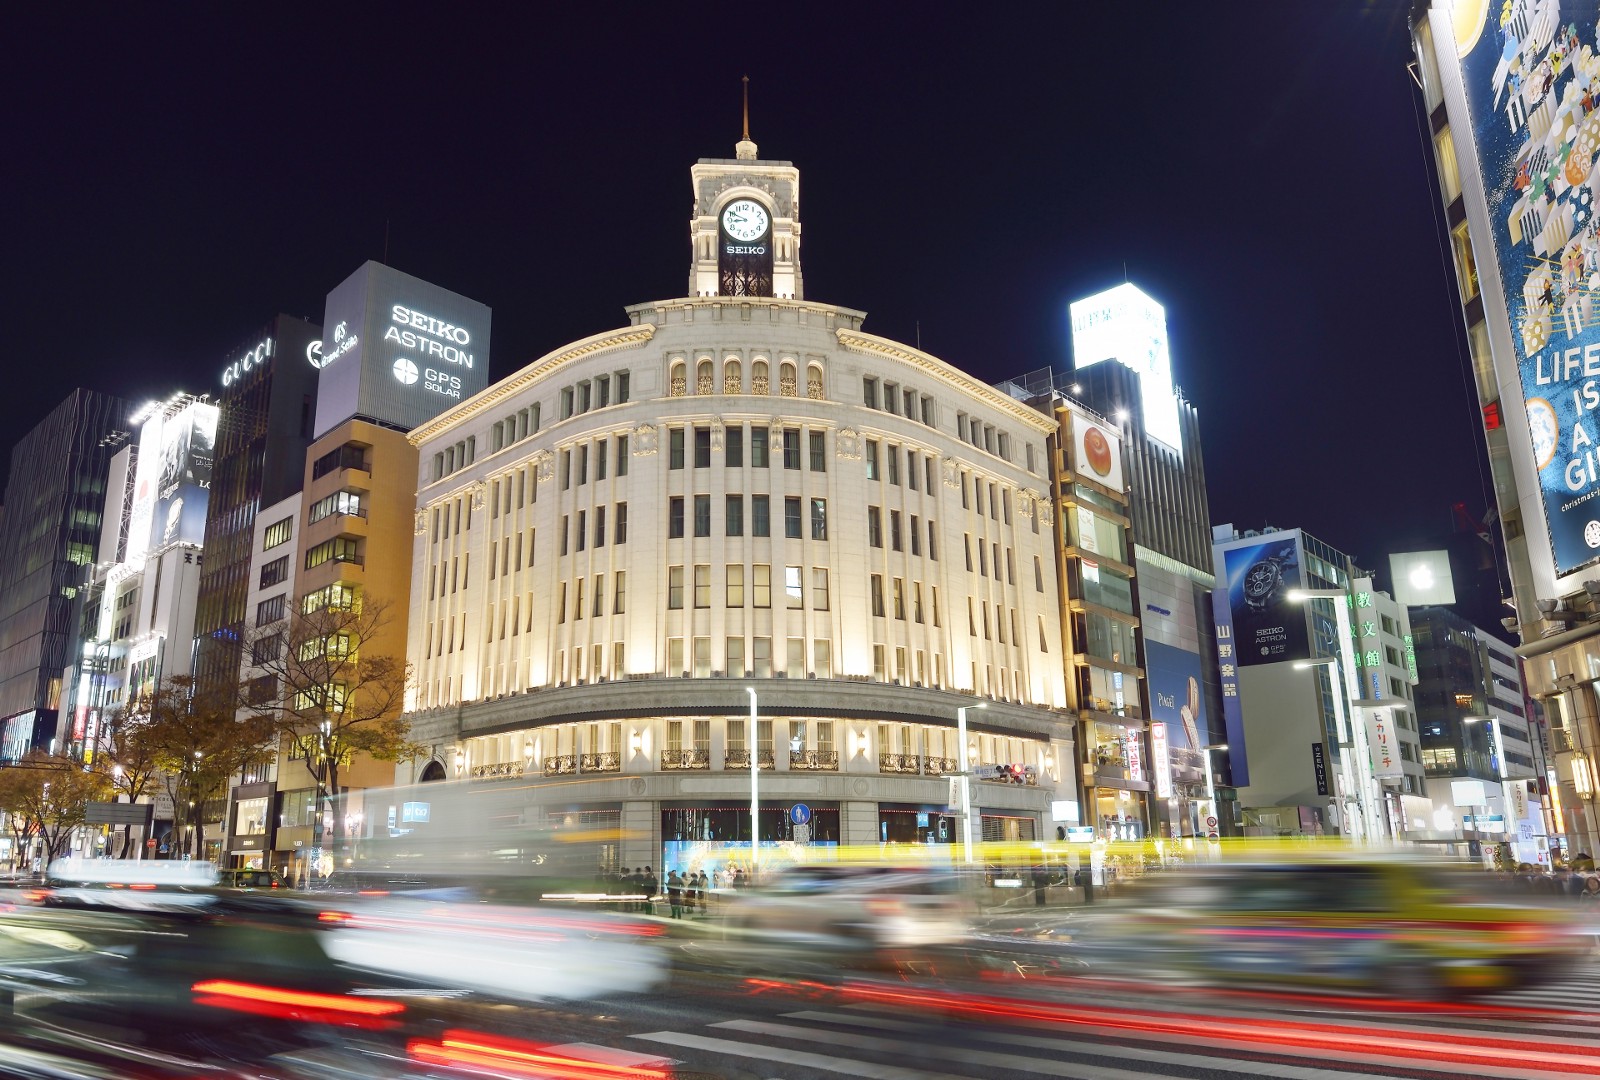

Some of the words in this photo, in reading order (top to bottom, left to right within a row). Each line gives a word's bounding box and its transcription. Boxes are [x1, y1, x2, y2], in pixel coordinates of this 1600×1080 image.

[726, 246, 765, 254] SEIKO
[392, 305, 470, 345] SEIKO
[222, 338, 272, 386] GUCCI
[384, 326, 473, 368] ASTRON
[1536, 343, 1600, 386] LIFE
[424, 368, 461, 390] GPS
[424, 381, 460, 400] SOLAR
[1573, 380, 1600, 417] IS
[1572, 422, 1591, 453] A
[1564, 446, 1600, 491] GI
[1255, 634, 1287, 644] ASTRON
[1256, 626, 1284, 636] SEIKO
[1357, 591, 1380, 667] 教文館
[1216, 625, 1237, 697] 山野楽器
[1158, 692, 1175, 710] PIAGET
[1373, 712, 1392, 768] ヒカリミチ
[1316, 752, 1325, 786] ZENITH
